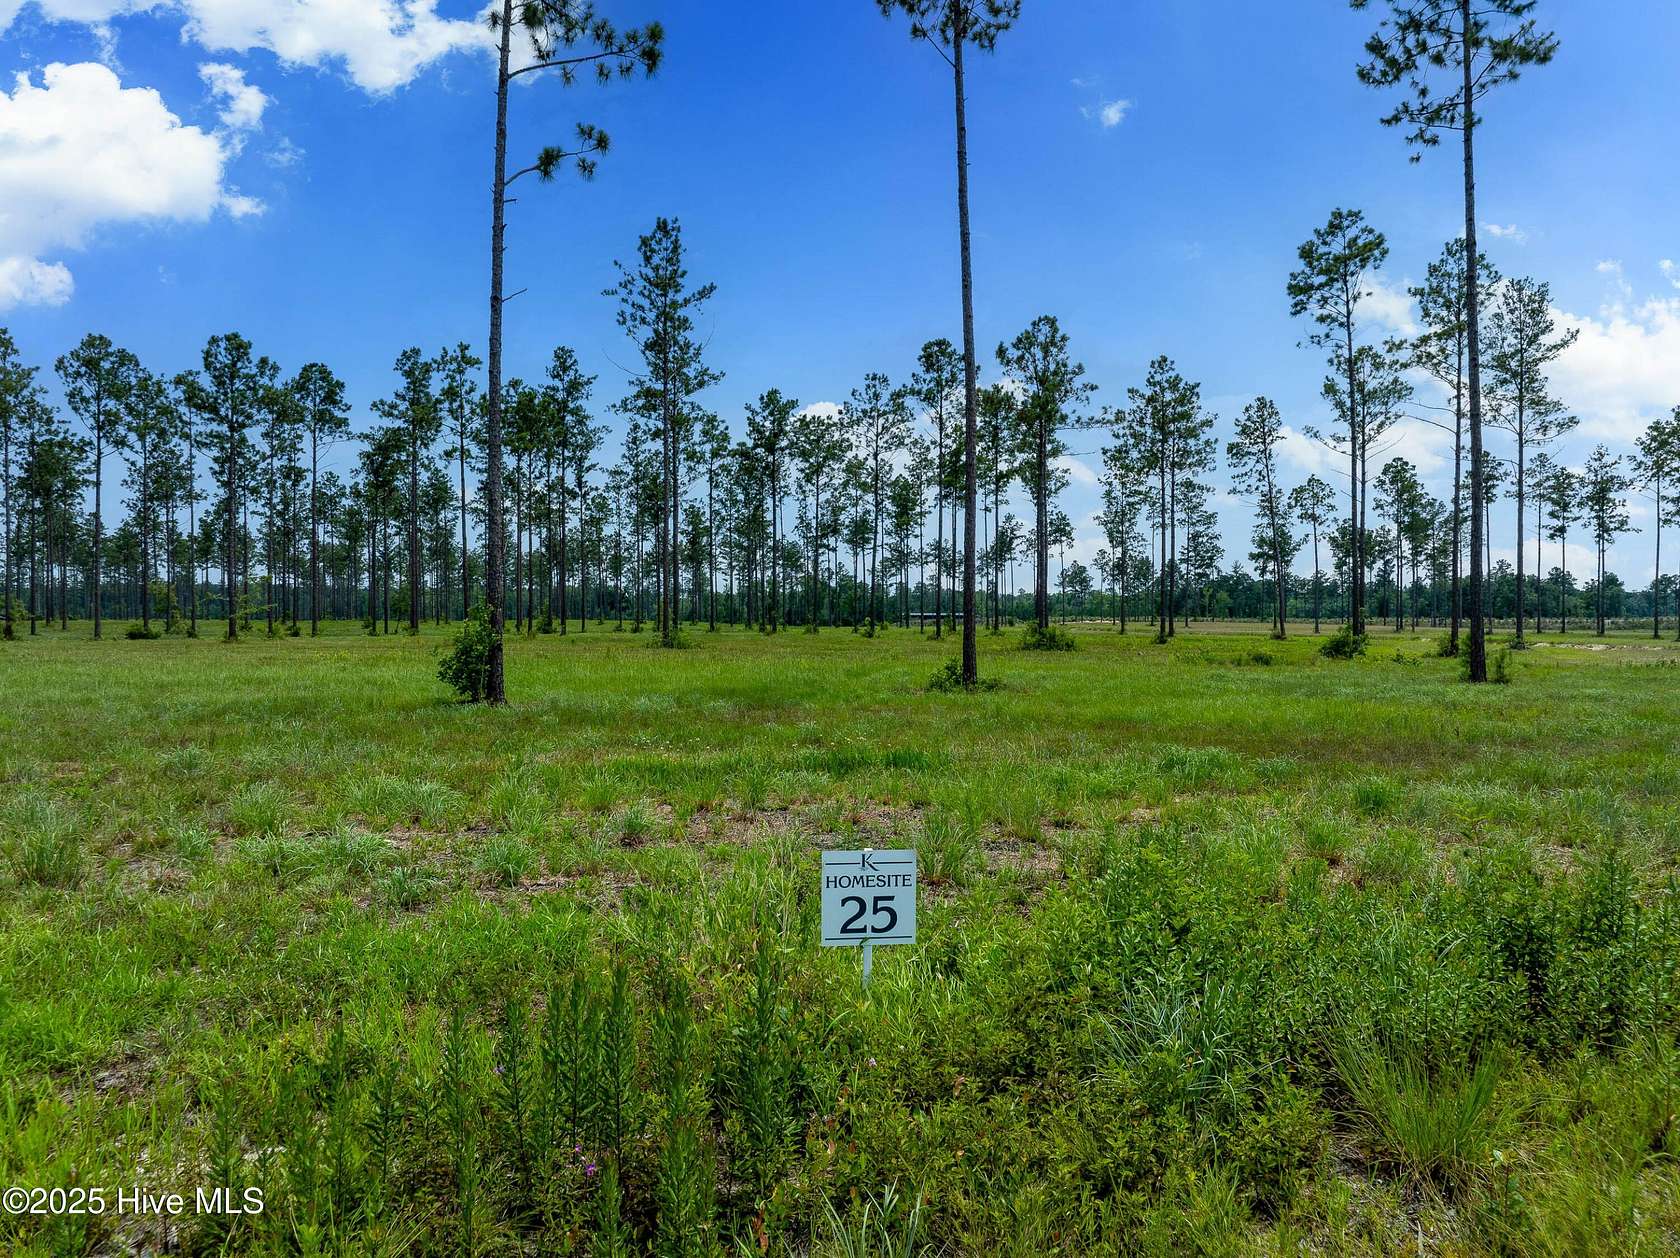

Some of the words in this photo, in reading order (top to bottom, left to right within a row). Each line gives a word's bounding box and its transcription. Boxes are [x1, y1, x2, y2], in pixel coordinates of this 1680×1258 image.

[860, 853, 880, 871] K
[825, 874, 912, 889] HOMESITE
[839, 895, 898, 934] 25
